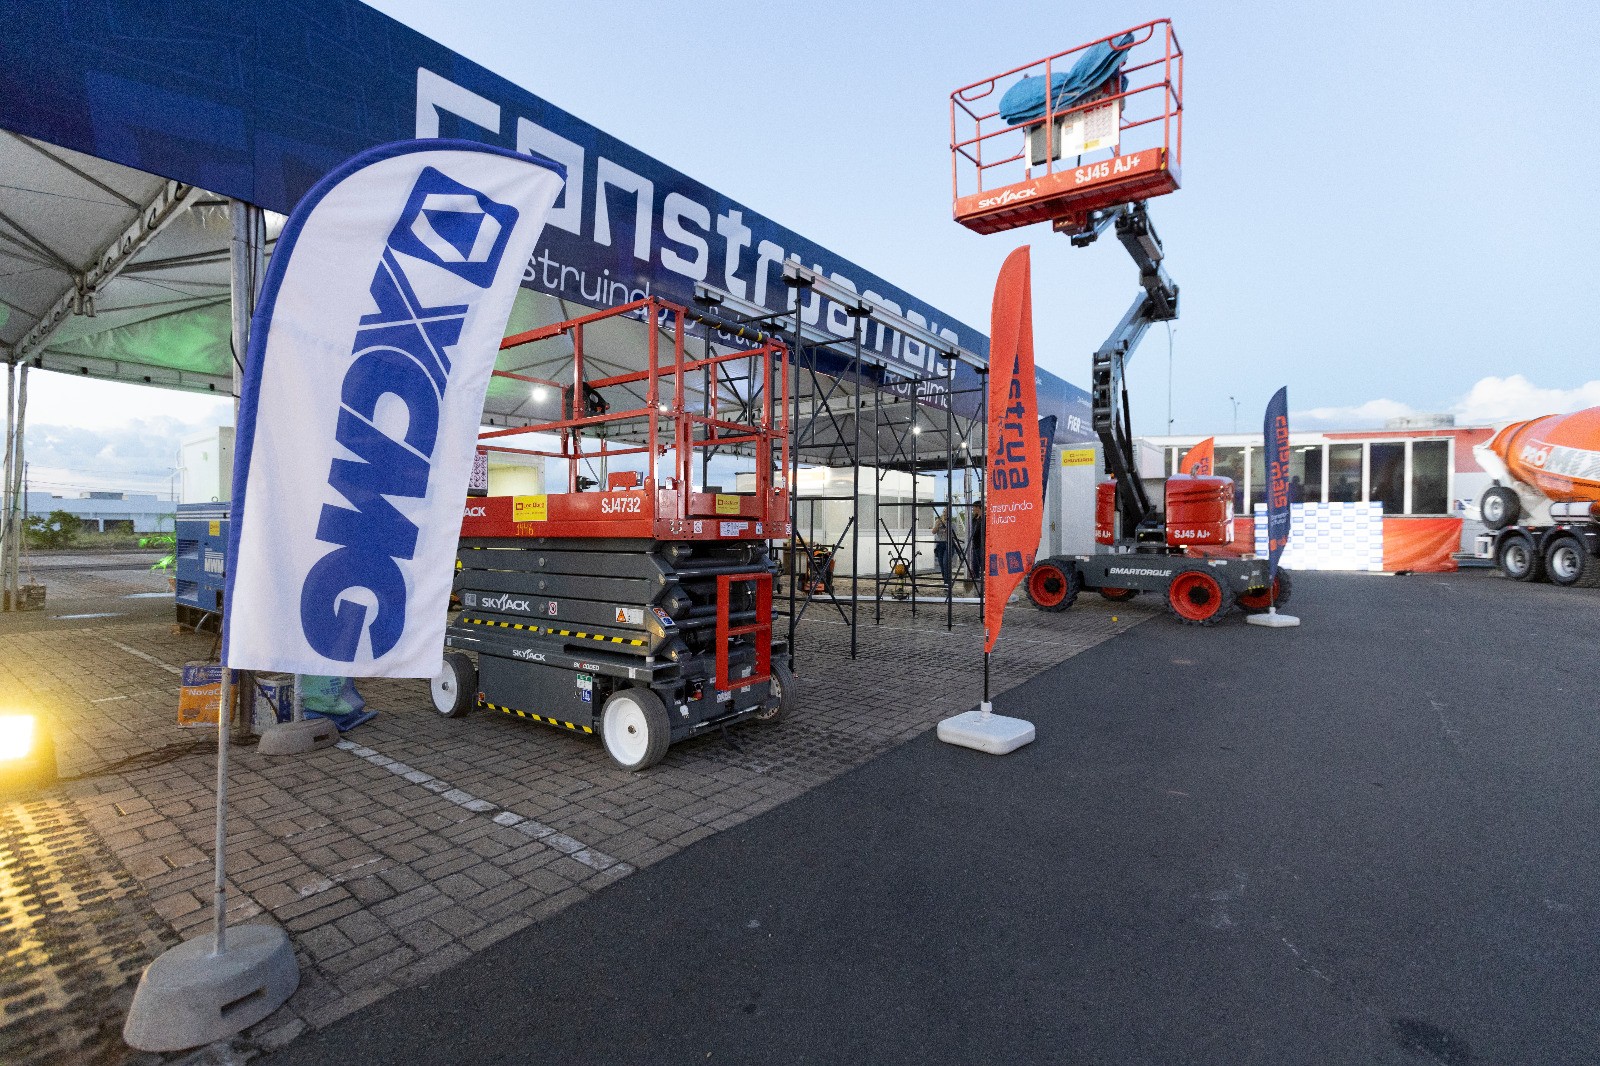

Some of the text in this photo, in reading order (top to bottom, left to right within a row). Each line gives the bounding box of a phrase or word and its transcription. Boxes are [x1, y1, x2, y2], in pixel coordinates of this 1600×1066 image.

[1074, 154, 1141, 184] SJ45 AJ+
[977, 187, 1038, 209] SKYJACK
[601, 497, 641, 514] SJ4732
[1174, 530, 1211, 539] SJ45 AJ+
[1109, 567, 1172, 577] SMARTORQUE
[481, 594, 531, 612] SKYJACK
[512, 648, 546, 662] SKYJACK
